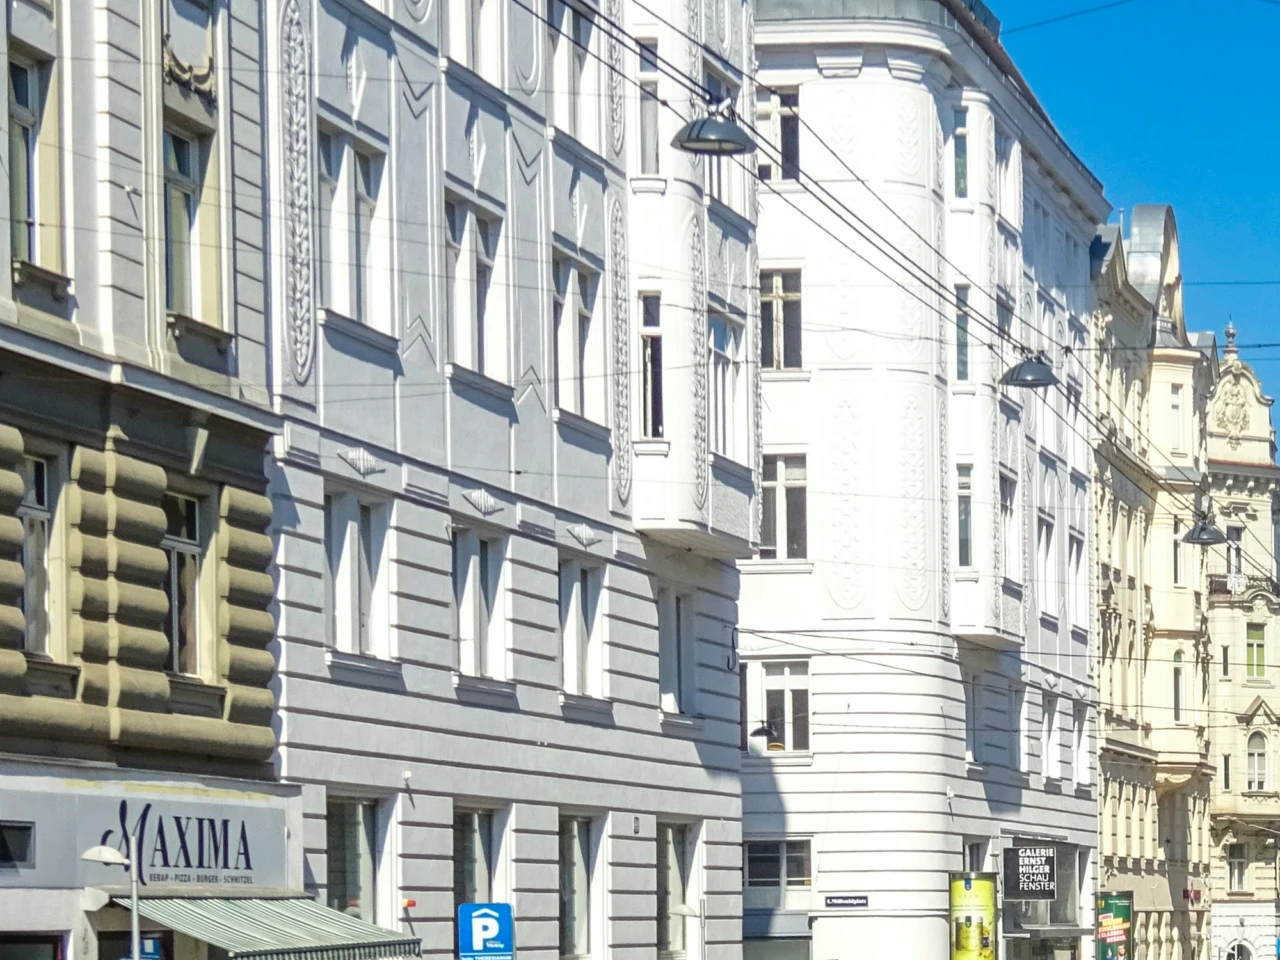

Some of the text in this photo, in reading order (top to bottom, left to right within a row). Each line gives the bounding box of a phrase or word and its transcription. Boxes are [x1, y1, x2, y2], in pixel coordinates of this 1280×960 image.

[101, 800, 253, 886] MAXIMA
[1018, 848, 1054, 857] GALERIE
[1018, 857, 1046, 865] ERNST
[1018, 865, 1050, 873] HILGER
[149, 873, 253, 884] KEBAP PIZZA BURGER SCHNITZEL
[1018, 873, 1049, 882] SCHAU
[1019, 881, 1055, 890] FENSTER
[472, 917, 499, 951] P
